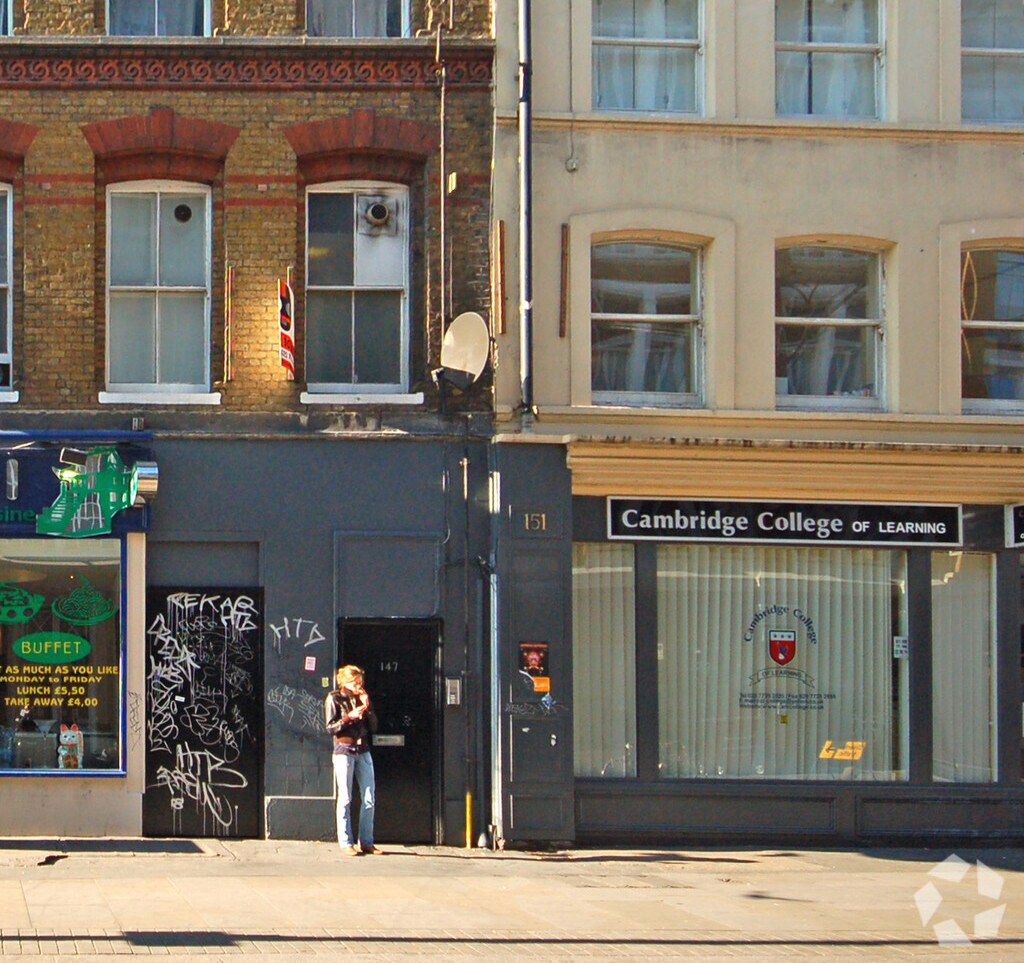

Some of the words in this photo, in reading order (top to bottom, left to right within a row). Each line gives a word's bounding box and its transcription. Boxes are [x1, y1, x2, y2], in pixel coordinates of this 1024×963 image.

[525, 513, 546, 530] 151
[621, 509, 749, 537] Cambridge
[757, 512, 844, 539] College
[852, 521, 870, 533] OF
[879, 522, 947, 534] LEARNING
[744, 604, 789, 642] Cambridge
[793, 608, 817, 644] College
[21, 641, 81, 654] BUFFET
[5, 665, 19, 674] AS
[23, 665, 52, 674] MUCH
[55, 665, 69, 674] AS
[72, 665, 94, 674] YOU
[97, 665, 119, 674] LIKE
[380, 661, 398, 672] 147
[16, 686, 51, 695] LUNCH
[4, 697, 30, 706] TAKE
[33, 697, 64, 706] AWAY
